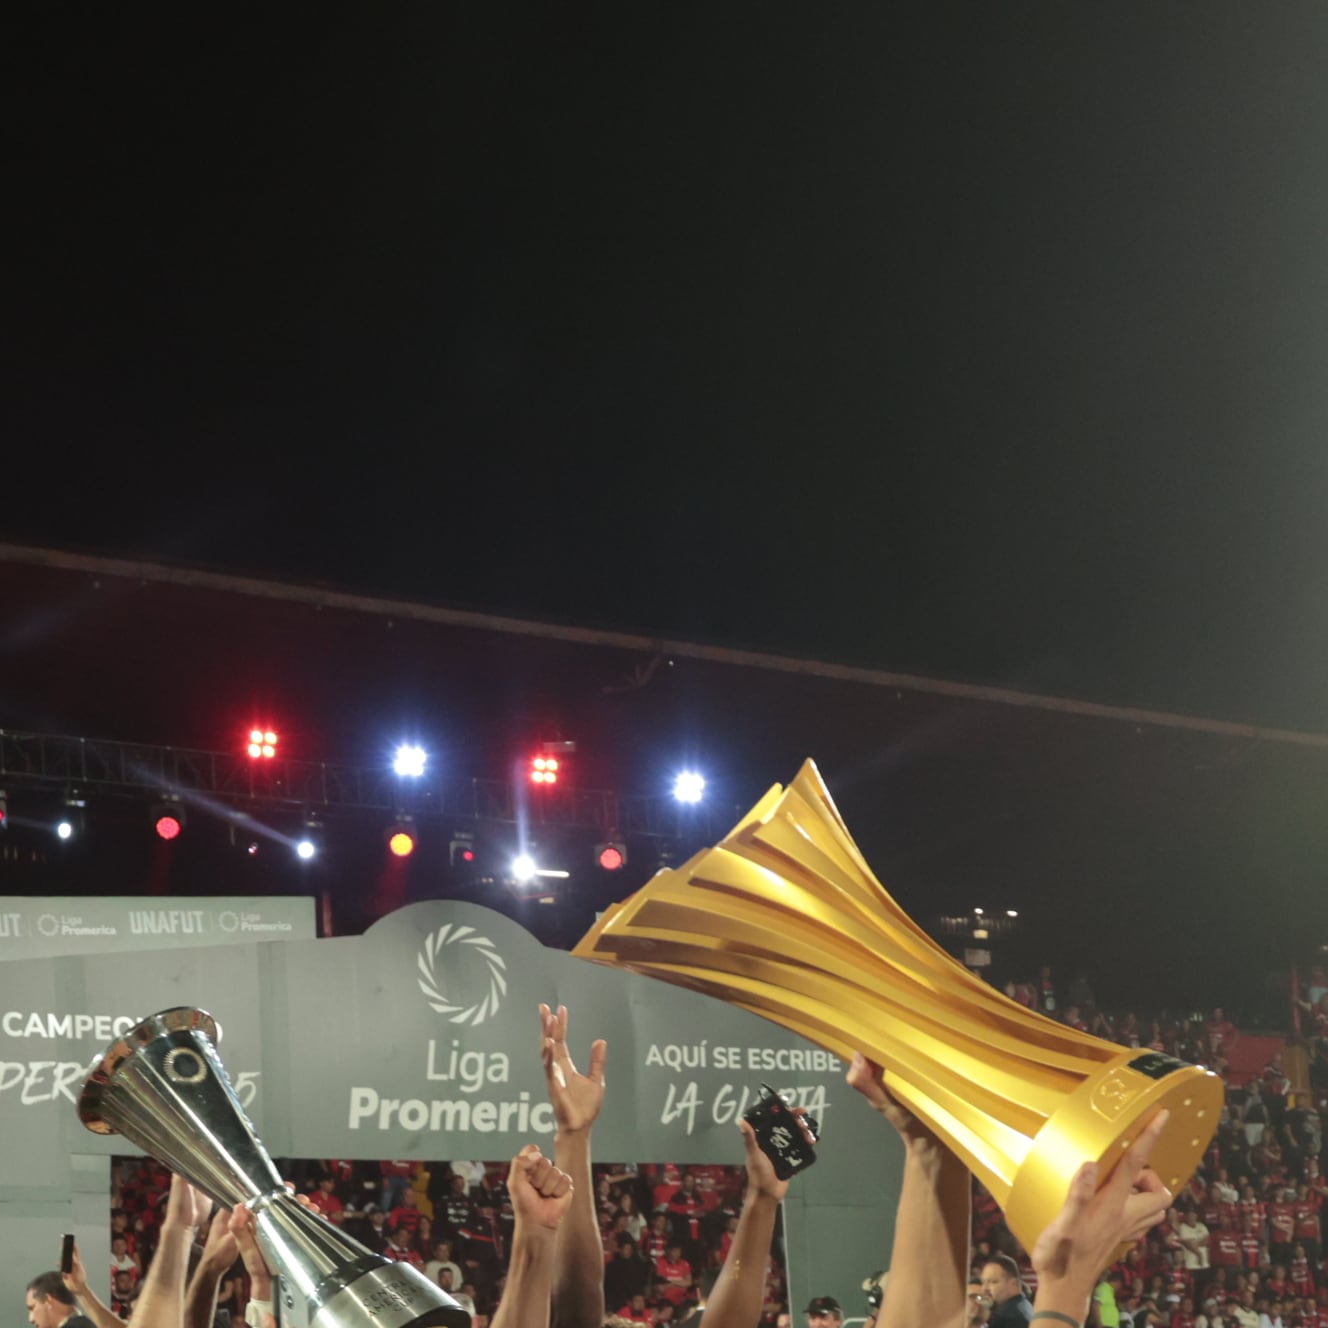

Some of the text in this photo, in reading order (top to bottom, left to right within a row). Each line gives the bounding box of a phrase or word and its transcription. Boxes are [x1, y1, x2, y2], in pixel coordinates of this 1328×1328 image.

[61, 924, 117, 937] Promerica
[129, 910, 204, 934] UNAFUT
[426, 1040, 510, 1092] Liga
[645, 1040, 841, 1073] AQUÍ SE ESCRIBE
[349, 1086, 558, 1134] Promeric
[661, 1082, 832, 1136] LA GLRIA
